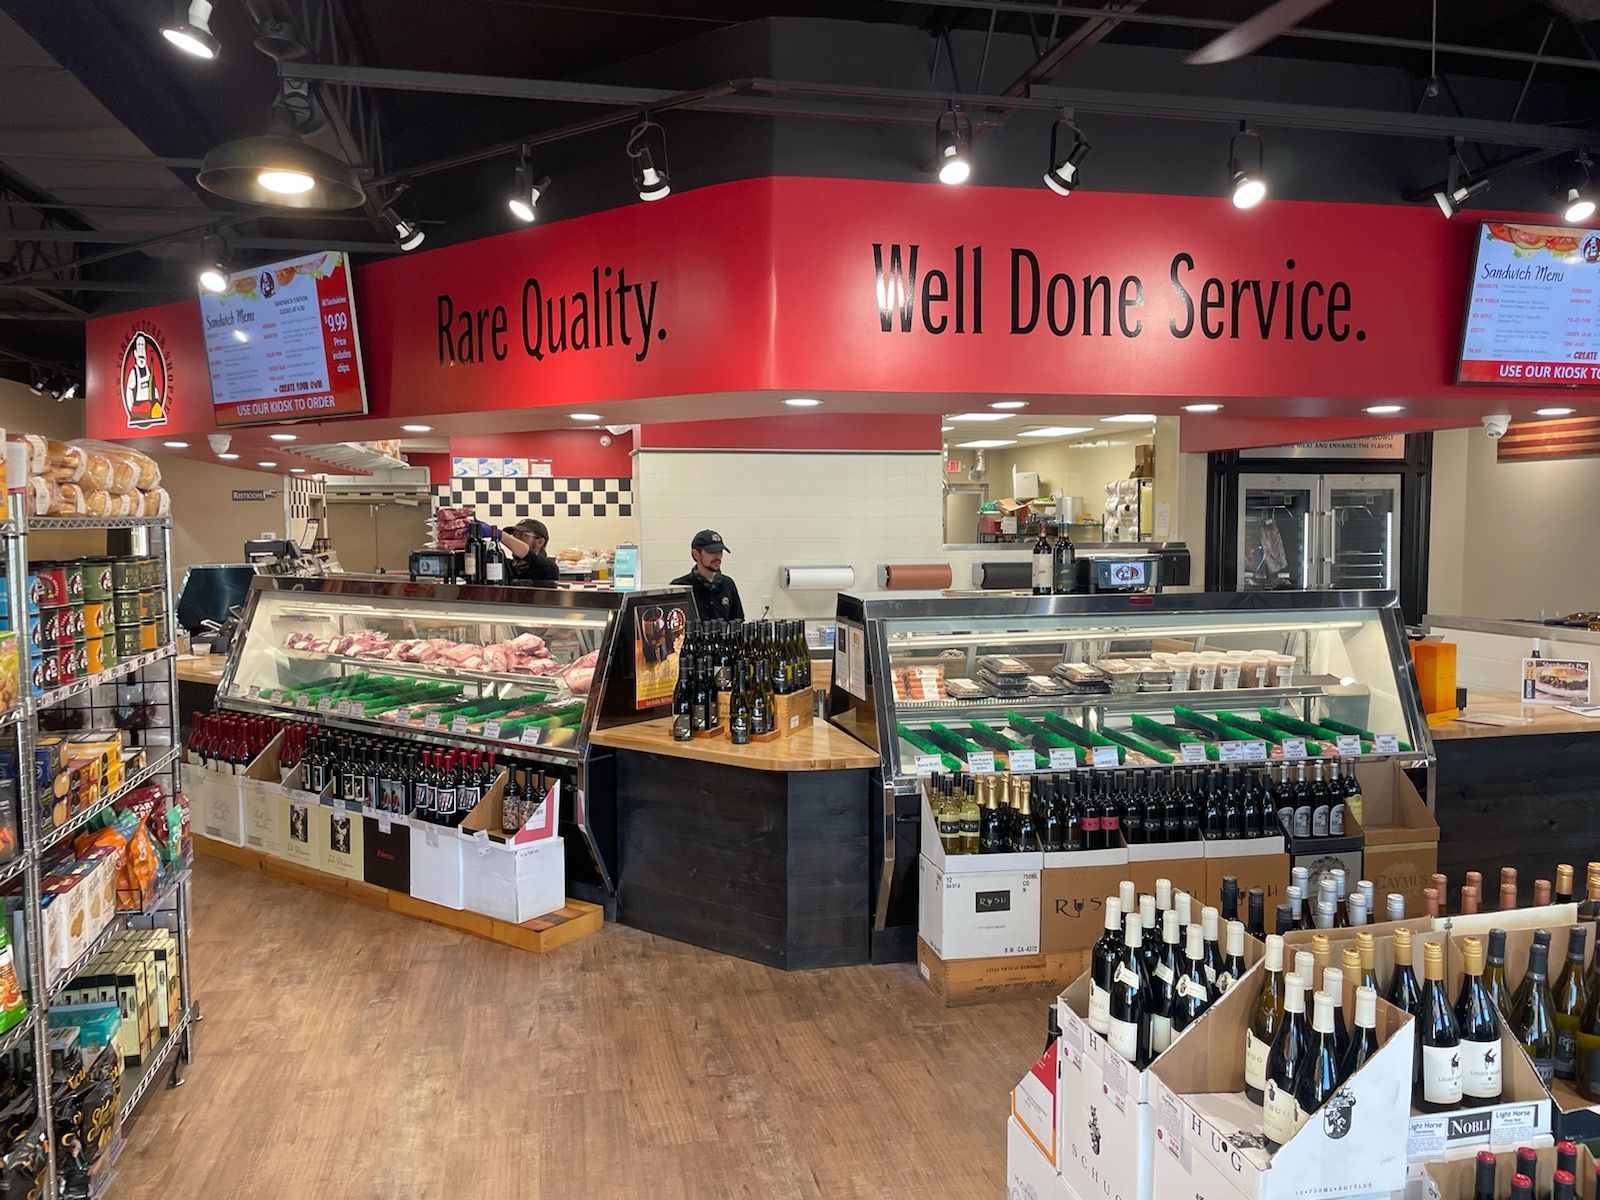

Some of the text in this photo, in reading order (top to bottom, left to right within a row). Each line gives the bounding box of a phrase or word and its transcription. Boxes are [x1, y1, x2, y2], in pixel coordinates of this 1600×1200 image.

[1481, 262, 1565, 283] Sandwich Menu
[872, 243, 1367, 342] Well Done Service.
[206, 308, 255, 331] Sandwich Menu
[437, 265, 667, 367] Rare Quality.
[1573, 351, 1598, 360] CREATE
[1500, 364, 1523, 378] USE
[1525, 365, 1551, 378] OUR
[1554, 366, 1588, 380] KIOSK
[237, 395, 336, 417] USE OUR KIOSK TO ORDER
[1055, 897, 1103, 918] RUS
[1424, 1121, 1443, 1129] Horse
[1495, 1110, 1531, 1120] Light Horse
